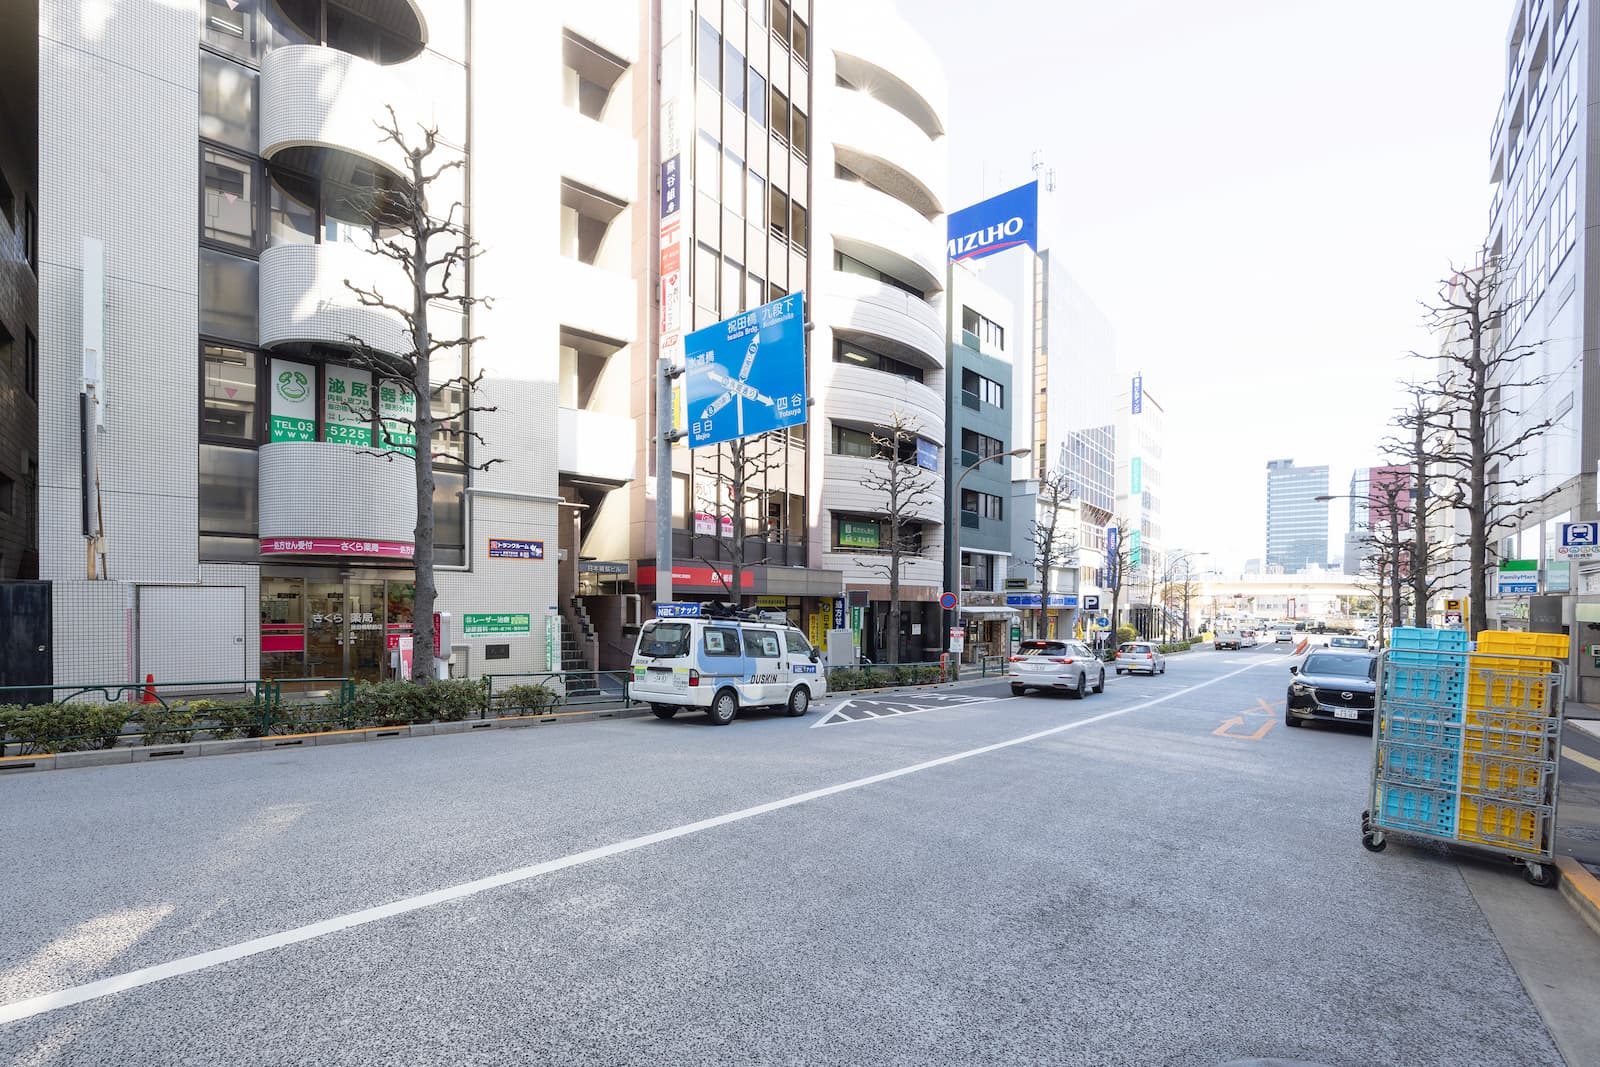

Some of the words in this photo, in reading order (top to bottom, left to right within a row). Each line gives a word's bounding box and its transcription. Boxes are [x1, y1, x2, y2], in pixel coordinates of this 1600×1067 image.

[947, 217, 1024, 257] MIZUHO
[762, 298, 794, 321] 九段下
[728, 313, 757, 333] 祝田橋
[777, 393, 802, 411] 四谷
[692, 420, 713, 434] 目白
[274, 540, 313, 550] 処方せん受付
[341, 542, 379, 552] さくら薬局
[1086, 598, 1098, 608] P
[1448, 600, 1458, 609] P
[680, 606, 698, 615] ナック
[312, 613, 373, 624] さくら薬局
[750, 673, 778, 685] DUSKIN
